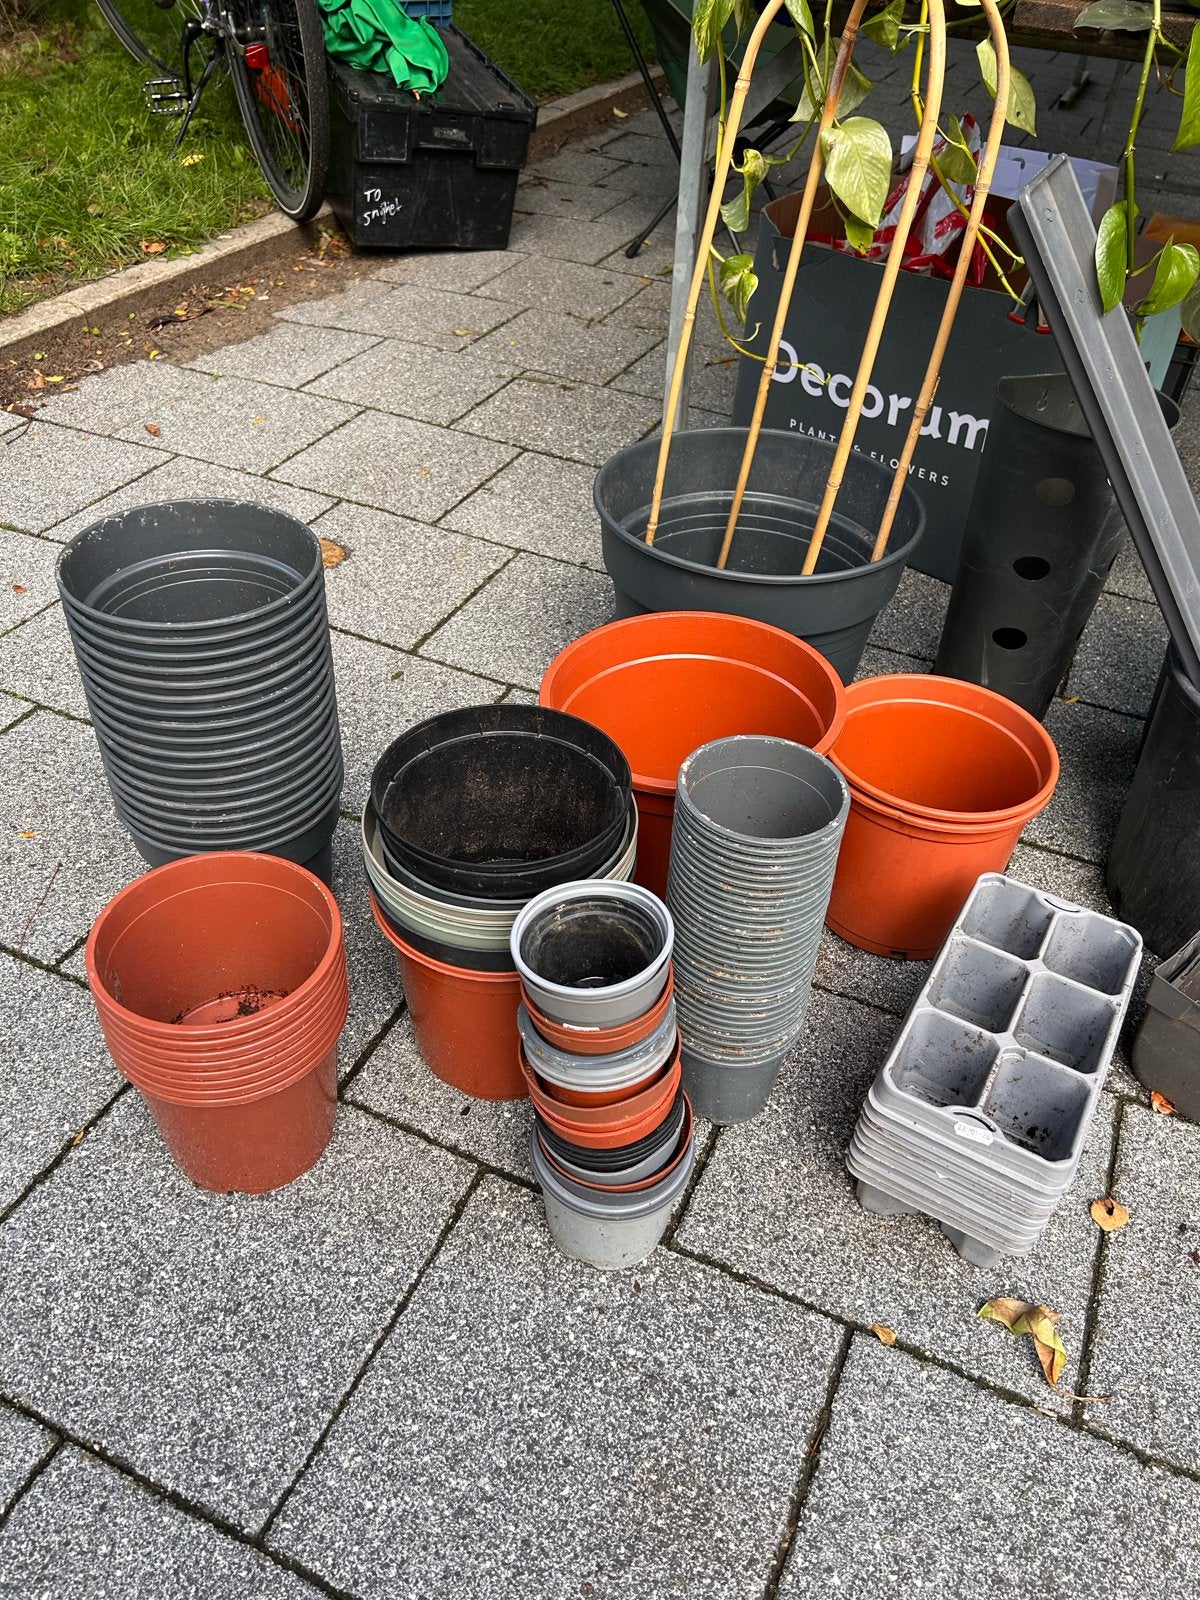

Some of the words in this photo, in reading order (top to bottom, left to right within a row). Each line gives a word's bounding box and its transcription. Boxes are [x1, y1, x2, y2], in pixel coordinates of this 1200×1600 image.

[363, 188, 382, 203] TO
[771, 339, 990, 453] Decorum
[789, 418, 840, 443] PLANT
